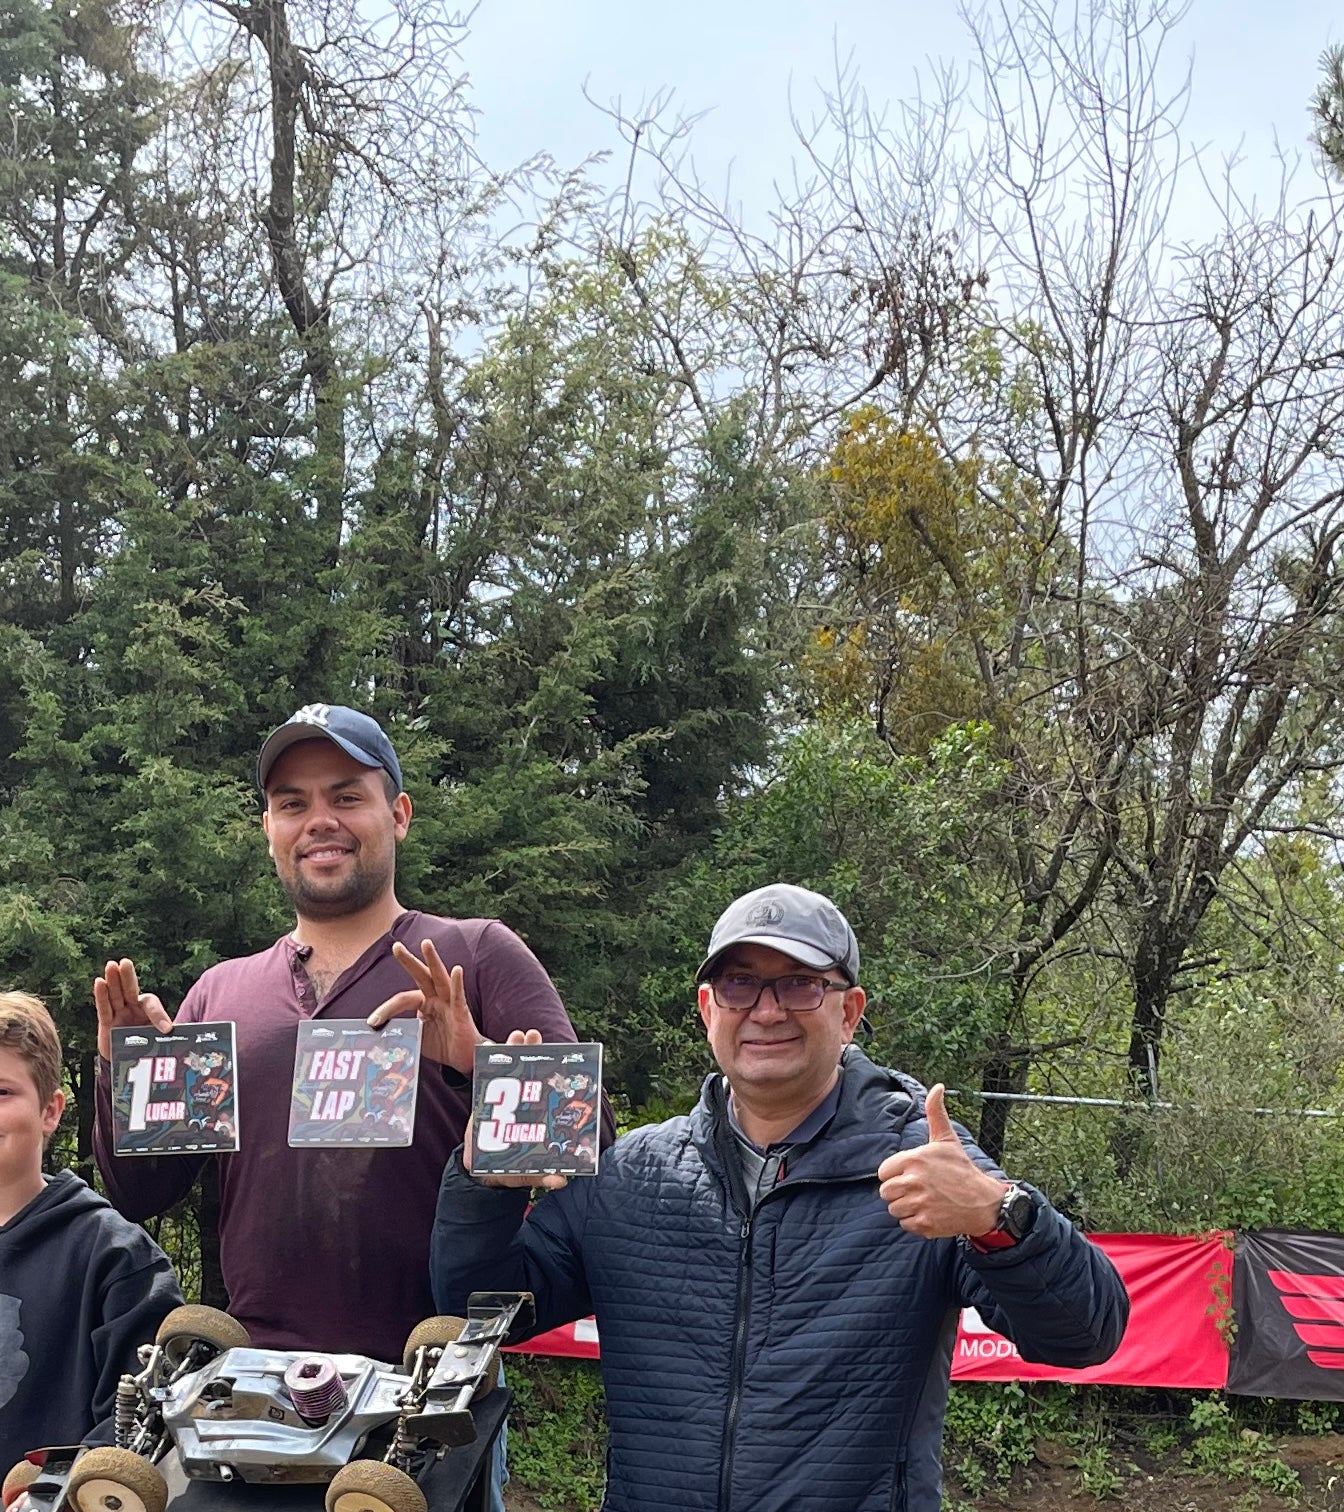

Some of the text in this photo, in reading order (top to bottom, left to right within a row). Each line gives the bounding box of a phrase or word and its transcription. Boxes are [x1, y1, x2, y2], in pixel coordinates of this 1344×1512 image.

[309, 1050, 366, 1080] FAST
[145, 1101, 186, 1121] LUGAR
[310, 1090, 356, 1120] LAP
[504, 1123, 546, 1142] LUGAR
